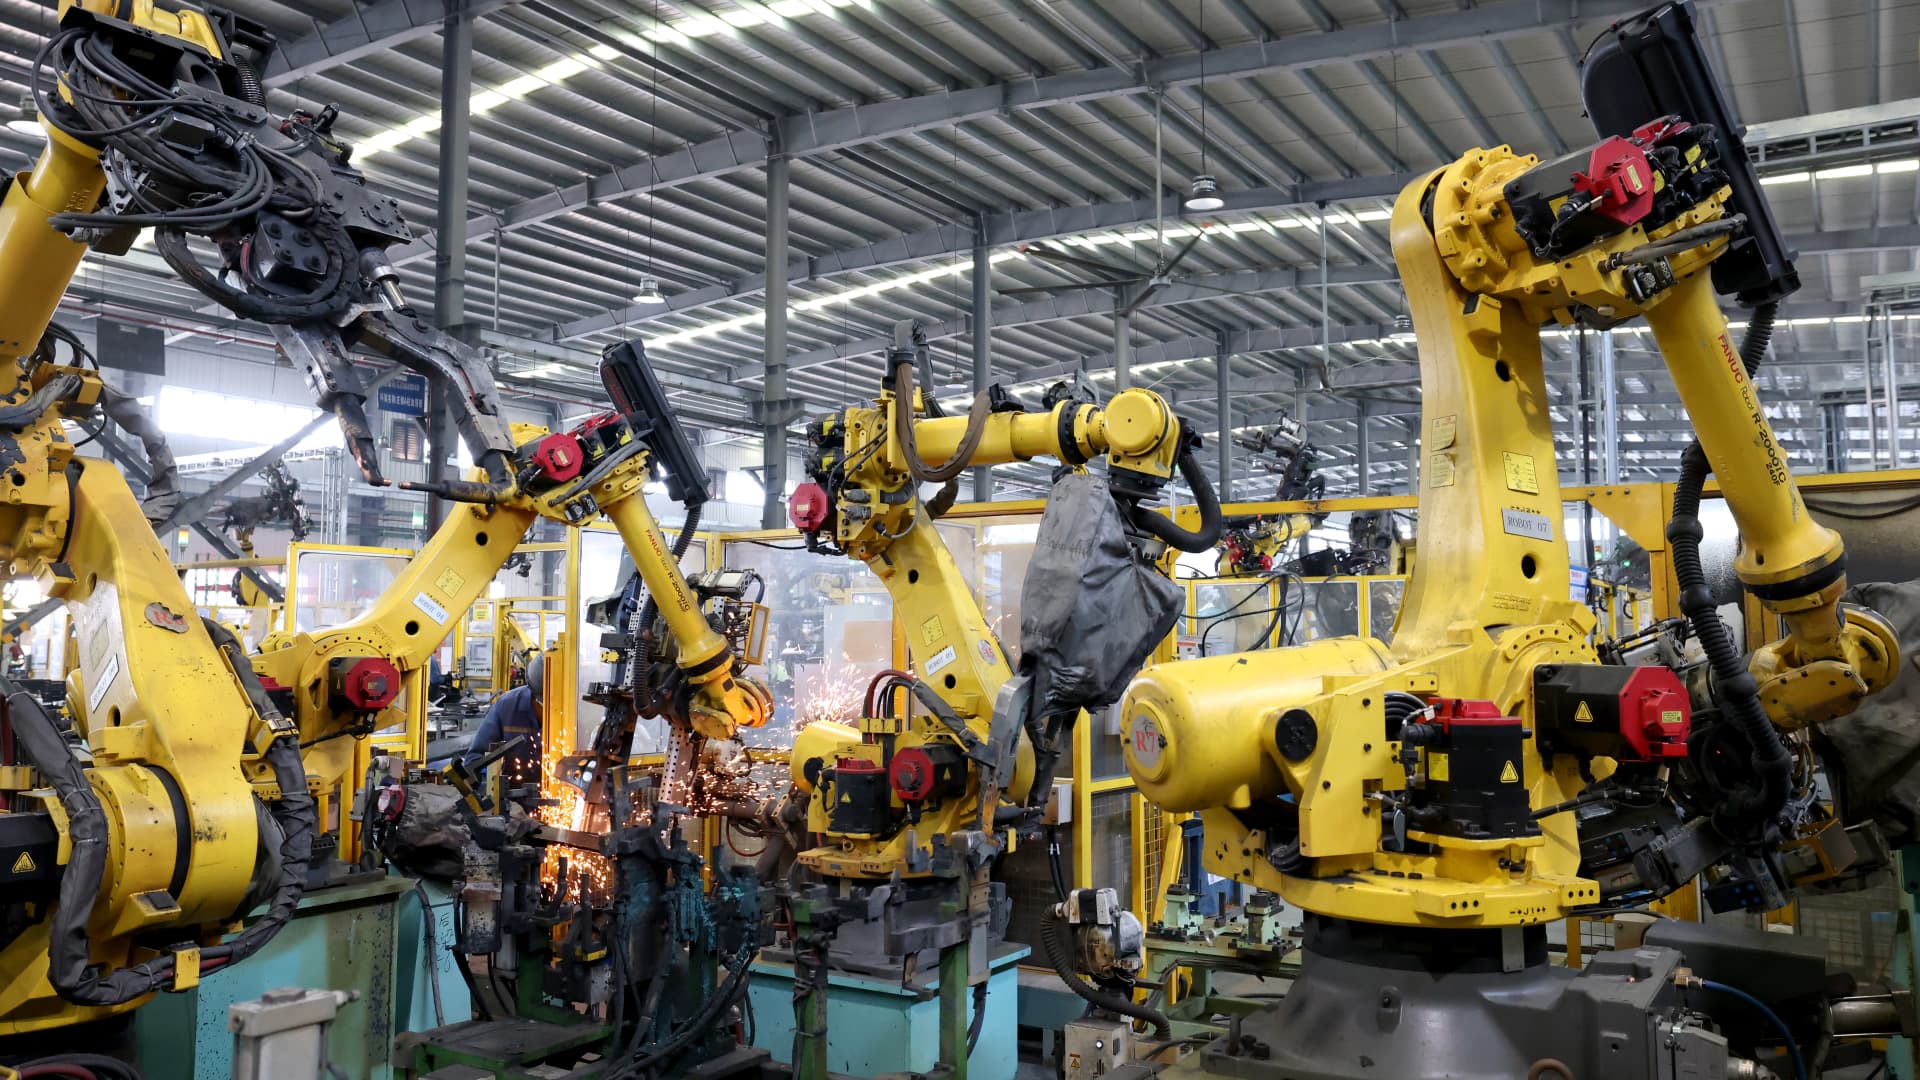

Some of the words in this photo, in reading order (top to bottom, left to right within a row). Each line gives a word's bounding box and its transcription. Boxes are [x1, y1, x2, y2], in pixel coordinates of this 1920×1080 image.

[1718, 334, 1743, 384] FANUC
[1740, 386, 1754, 410] Robot
[1765, 463, 1781, 486] 240F
[1507, 515, 1532, 530] ROBOT
[1537, 521, 1547, 532] 07
[645, 529, 662, 557] FANUC
[1135, 730, 1155, 752] R7
